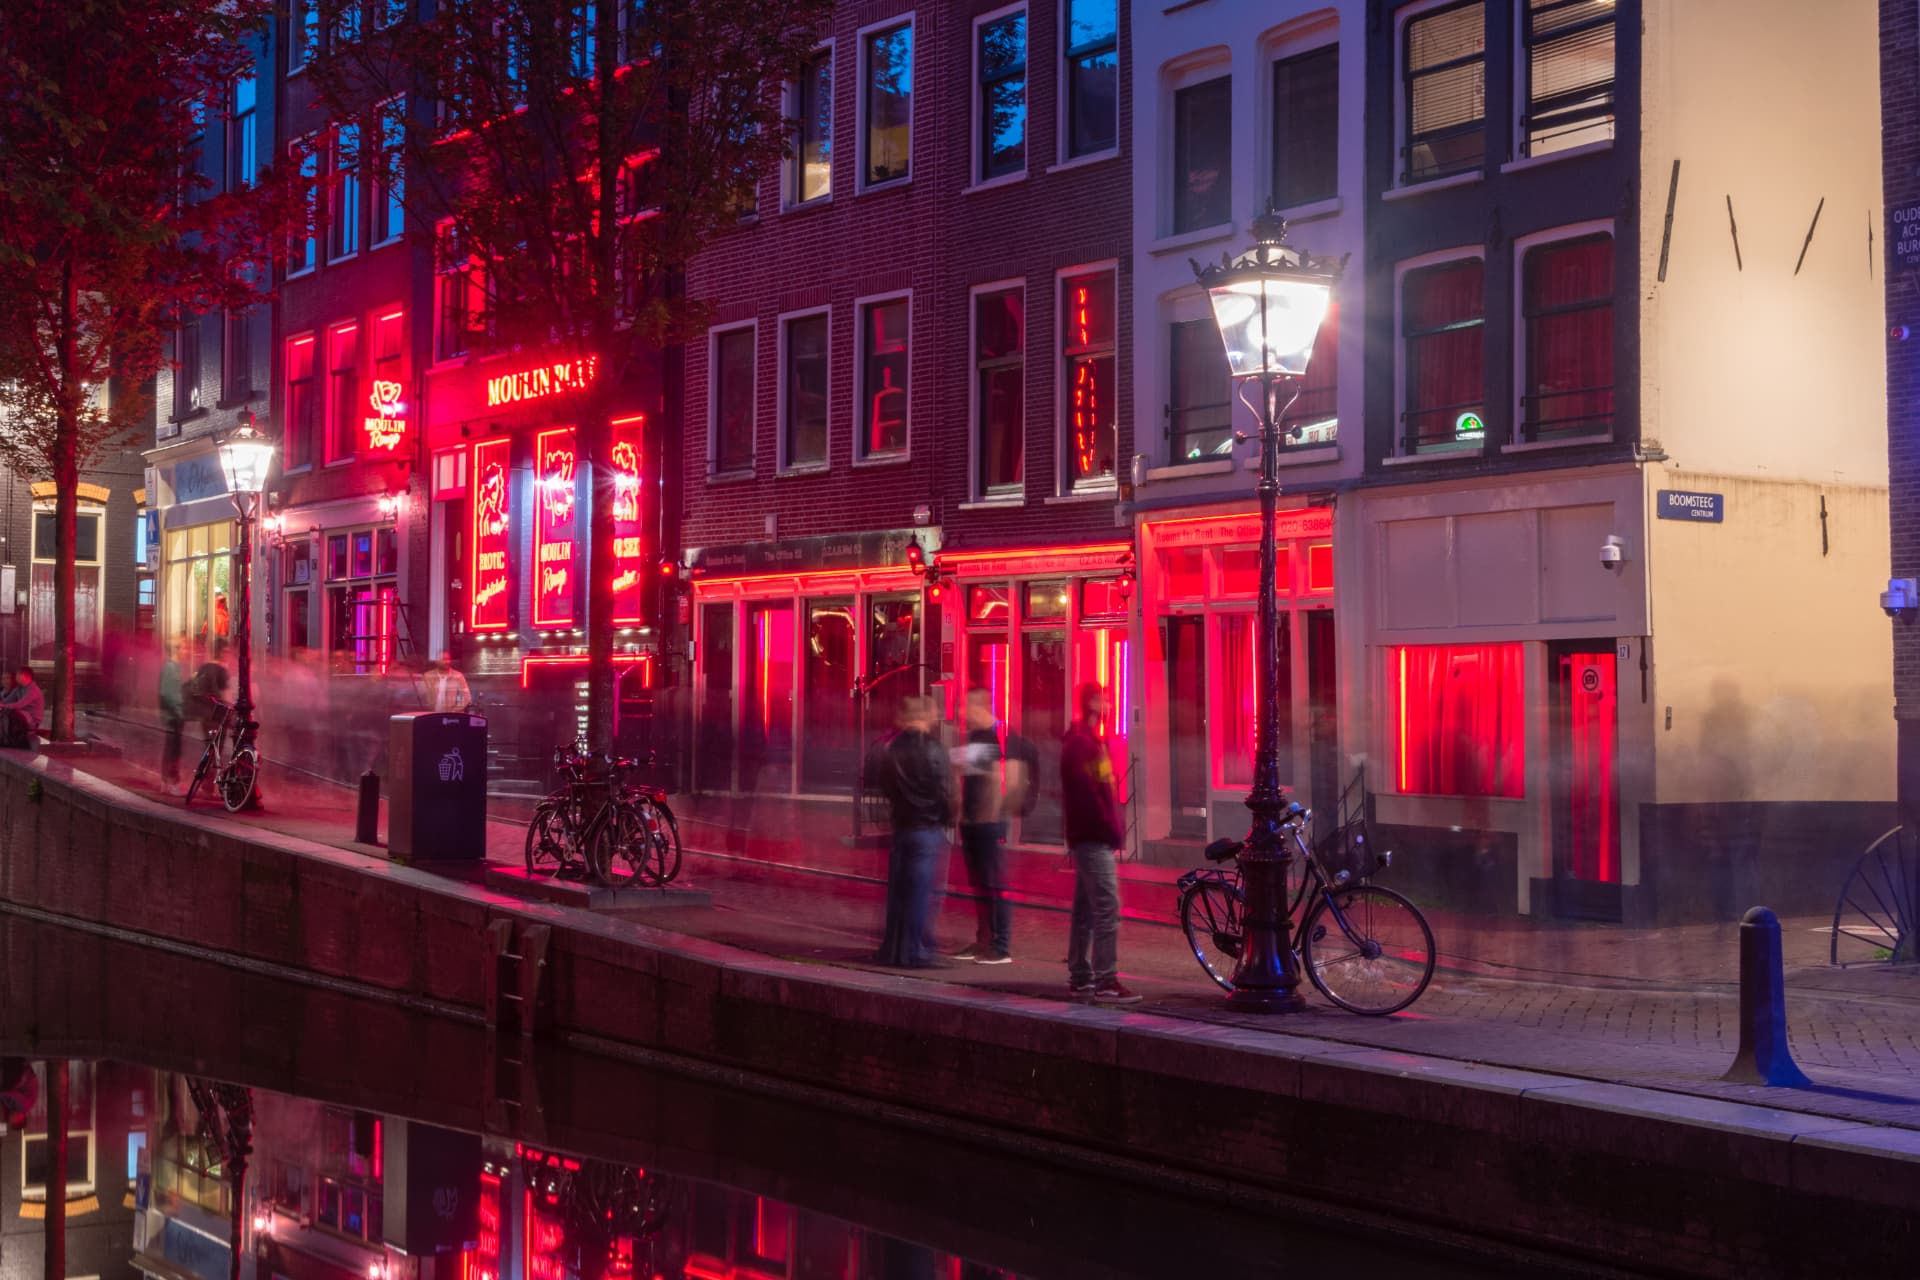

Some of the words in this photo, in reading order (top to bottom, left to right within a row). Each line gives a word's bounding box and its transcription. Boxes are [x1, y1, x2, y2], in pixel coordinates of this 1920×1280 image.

[487, 367, 550, 406] MOULIN
[365, 417, 406, 433] MOULIN
[1669, 494, 1714, 508] BOOMSTEEG
[1220, 526, 1234, 538] The
[540, 541, 572, 562] MOULIN
[479, 551, 505, 571] EROTIC
